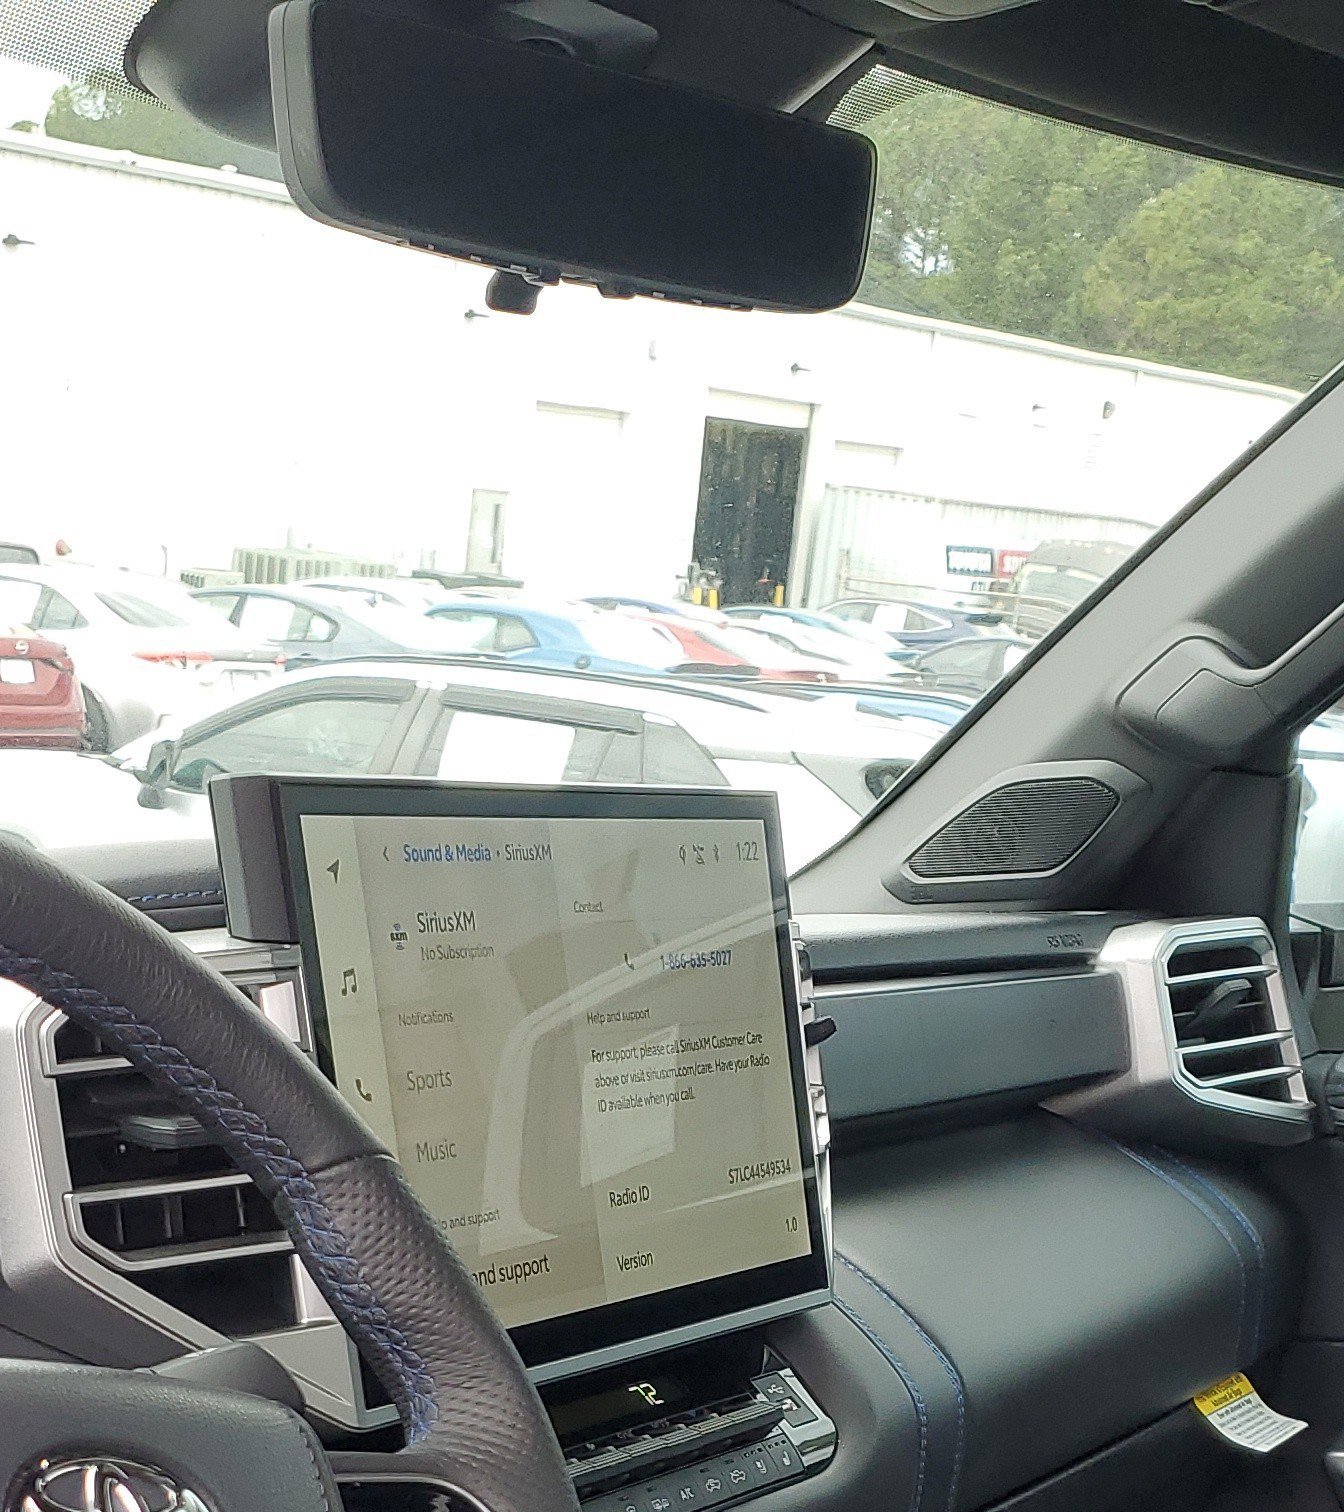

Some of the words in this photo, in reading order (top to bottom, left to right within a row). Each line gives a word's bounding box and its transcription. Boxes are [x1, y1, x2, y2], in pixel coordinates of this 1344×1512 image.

[403, 843, 442, 862] Sound
[444, 844, 454, 862] &
[456, 843, 491, 862] Media
[505, 843, 552, 861] SiriusXM
[736, 842, 759, 861] 1:22
[574, 901, 603, 913] Contact
[417, 911, 476, 933] SiriusXM
[421, 946, 436, 960] No
[437, 944, 494, 961] Subscription
[398, 1010, 454, 1026] Notifications
[587, 1012, 605, 1025] Help
[606, 1010, 621, 1023] and
[622, 1008, 650, 1023] support
[591, 1049, 605, 1063] For
[640, 1044, 665, 1058] please
[666, 1041, 679, 1055] call
[680, 1037, 711, 1053] SiriusXM
[712, 1034, 746, 1050] Customer
[746, 1031, 763, 1045] Care
[595, 1074, 619, 1088] above
[621, 1074, 629, 1085] or
[630, 1069, 645, 1083] visit
[715, 1058, 733, 1073] Have
[734, 1057, 749, 1073] your
[750, 1053, 770, 1067] Radio
[406, 1069, 453, 1094] Sports
[598, 1099, 606, 1113] ID
[608, 1095, 643, 1111] available
[644, 1091, 665, 1106] when
[666, 1090, 680, 1106] you
[416, 1139, 457, 1162] Music
[609, 1187, 638, 1208] Radio
[639, 1185, 650, 1202] ID
[449, 1213, 466, 1229] and
[468, 1208, 500, 1228] support
[786, 1216, 797, 1233] 1.0
[499, 1254, 550, 1284] support
[616, 1251, 653, 1272] Version
[628, 1382, 665, 1406] 72
[680, 1487, 695, 1501] A/C
